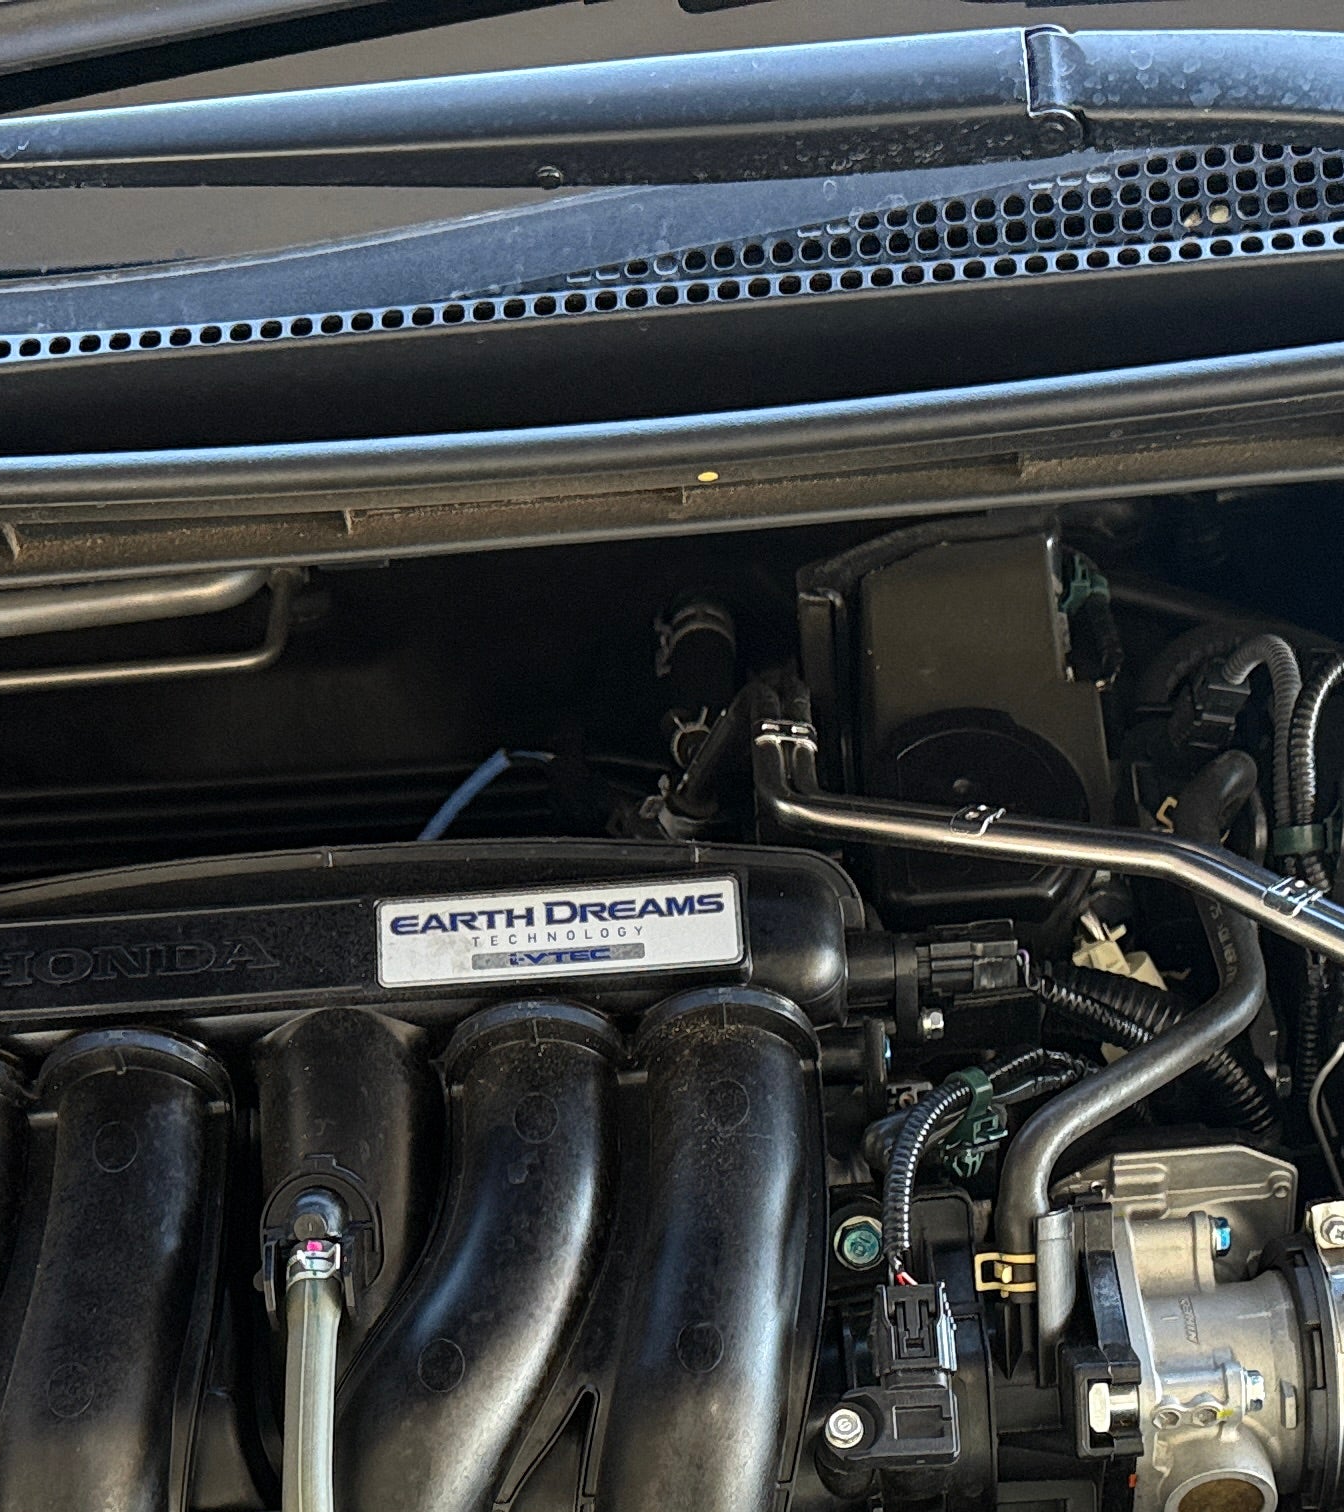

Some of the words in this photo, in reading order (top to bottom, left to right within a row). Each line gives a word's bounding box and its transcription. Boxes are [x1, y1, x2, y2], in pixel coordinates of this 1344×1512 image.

[390, 907, 536, 936] EARTH
[544, 893, 725, 925] DREAMS
[472, 926, 644, 947] TECHNOLOGY
